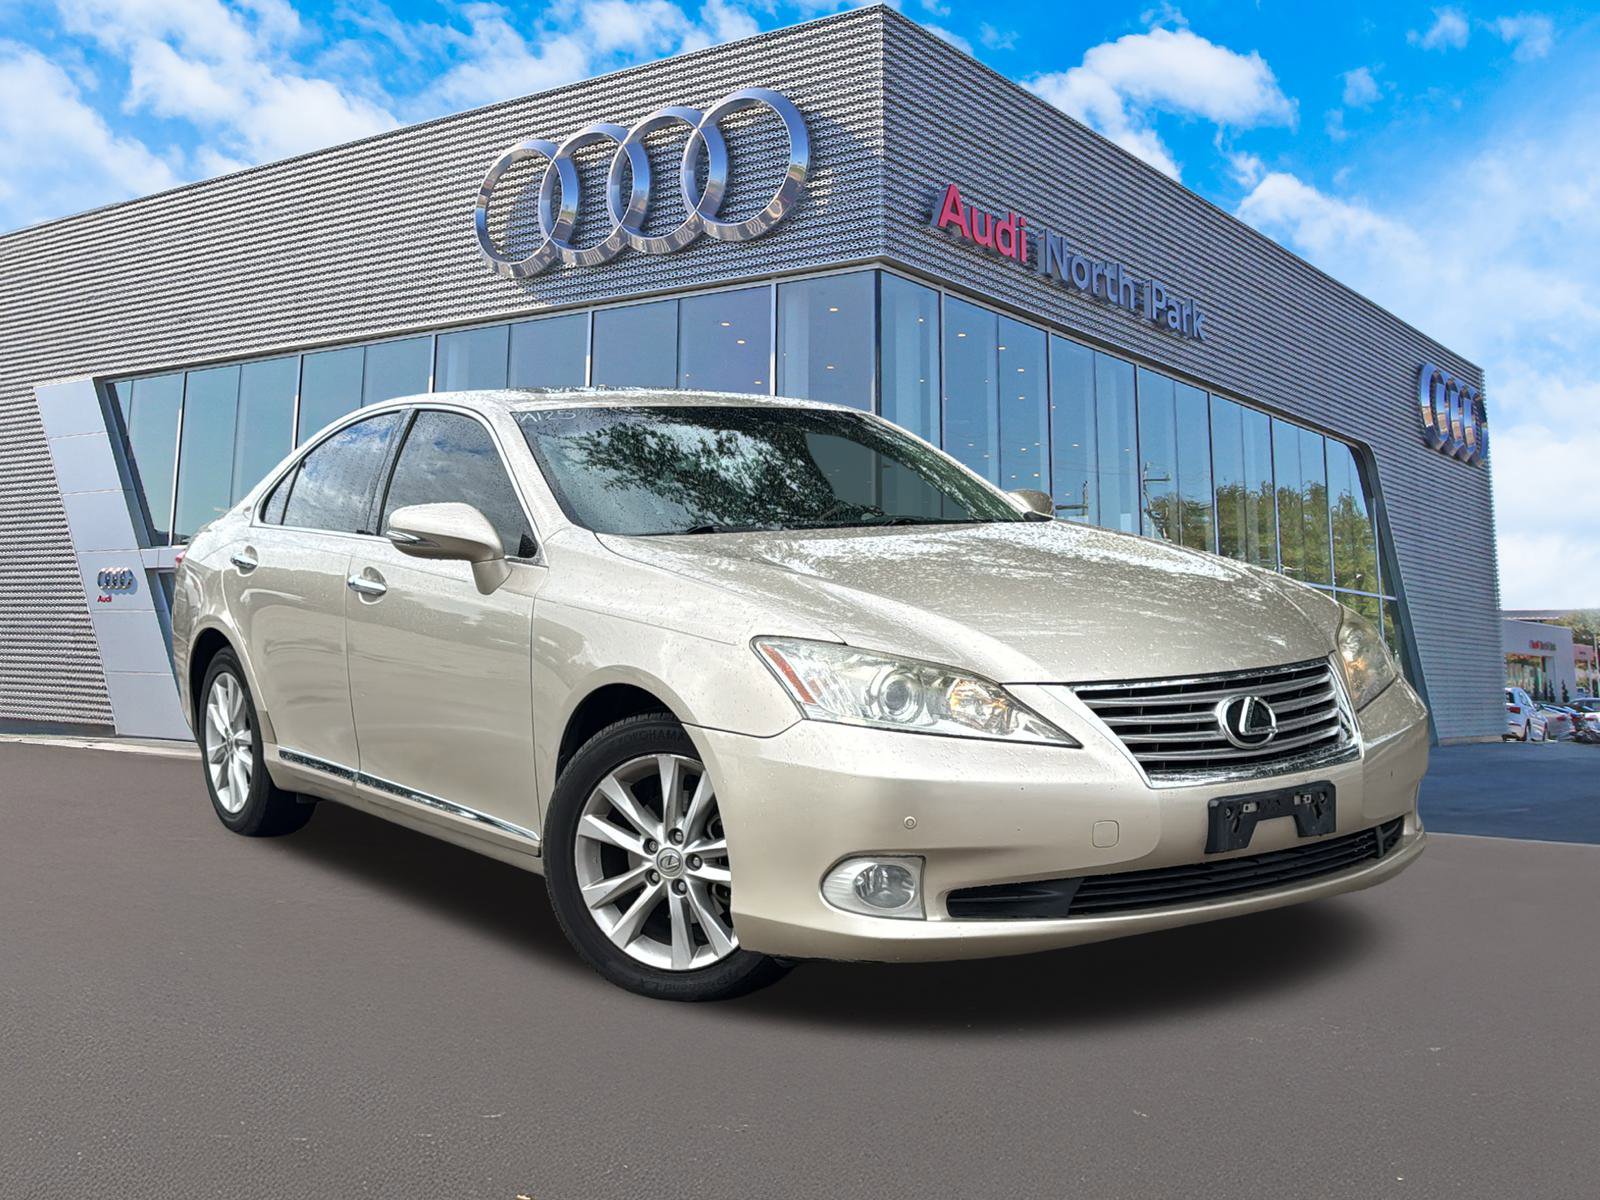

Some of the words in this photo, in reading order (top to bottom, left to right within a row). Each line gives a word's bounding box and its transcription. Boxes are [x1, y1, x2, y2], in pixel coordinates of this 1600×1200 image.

[932, 183, 1028, 263] Audi
[1040, 229, 1136, 310] North
[1146, 279, 1207, 341] Park
